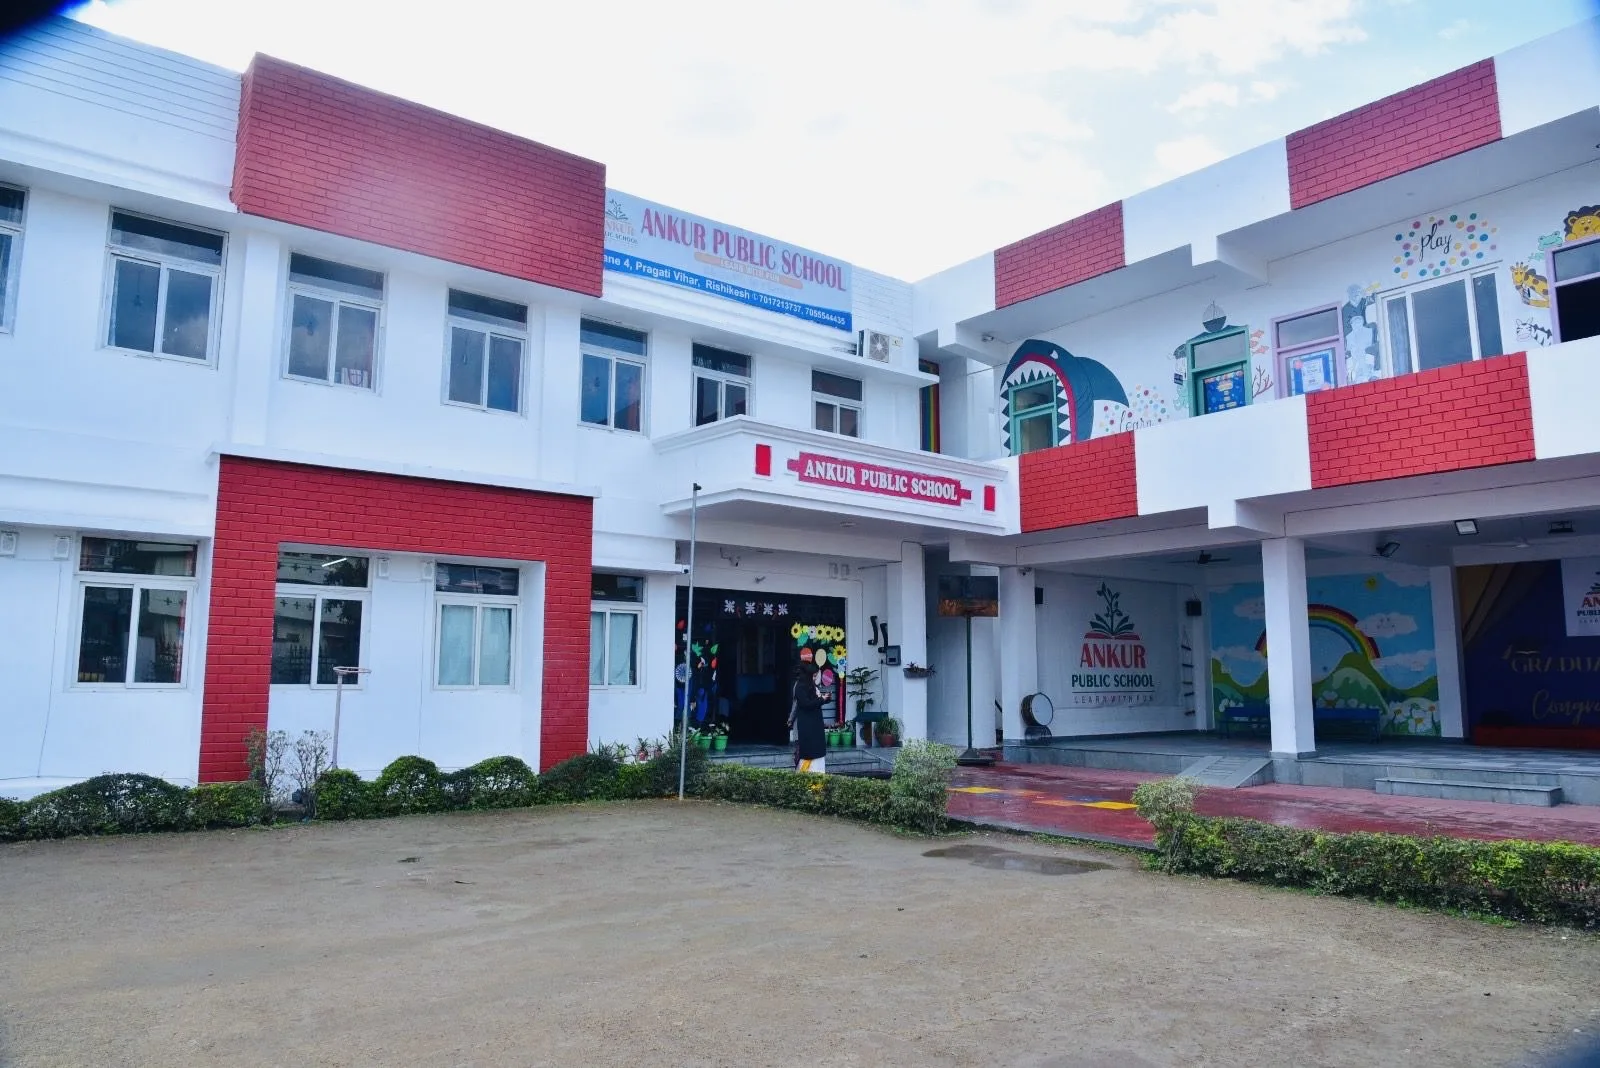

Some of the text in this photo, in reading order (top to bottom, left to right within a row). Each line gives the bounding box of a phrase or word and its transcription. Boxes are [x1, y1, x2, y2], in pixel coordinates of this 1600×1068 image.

[641, 207, 847, 292] ANKUR PUBLIC SCHOOL
[1418, 222, 1452, 262] play
[623, 258, 633, 271] 4,
[635, 260, 671, 278] Pragati
[673, 270, 701, 288] Vihar,
[705, 279, 750, 299] Rishikesh
[1119, 410, 1153, 432] learn
[804, 459, 958, 501] ANKUR PUBLIC SCHOOL
[1080, 642, 1147, 669] ANKUR
[1071, 674, 1155, 688] PUBLIC SCHOOL
[1074, 695, 1107, 704] LEARN
